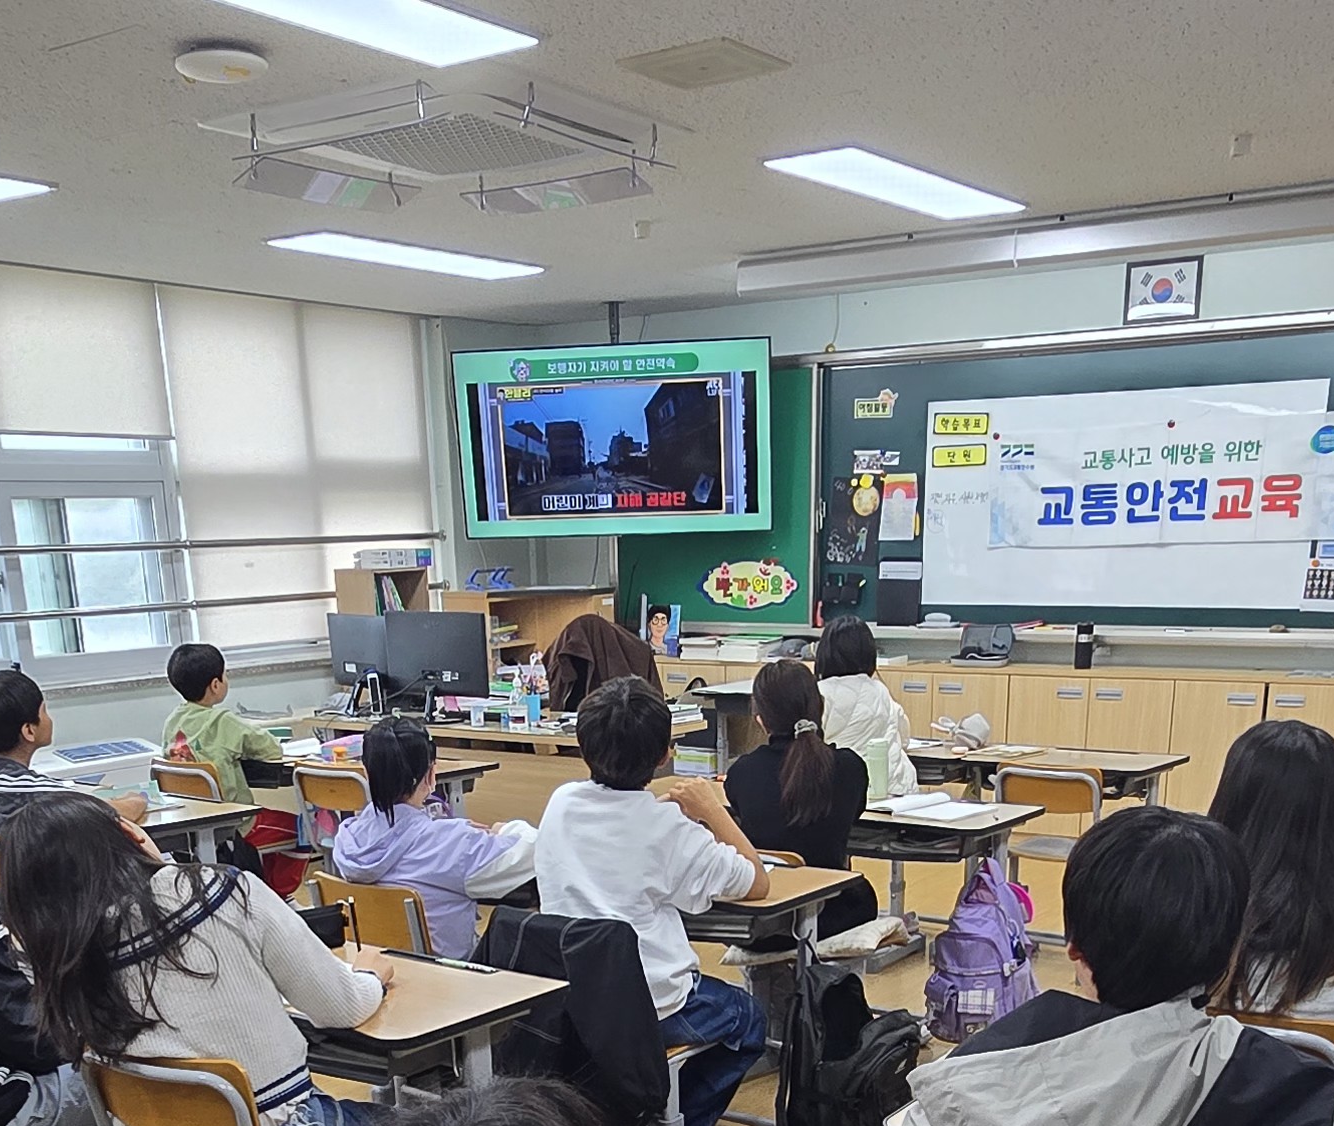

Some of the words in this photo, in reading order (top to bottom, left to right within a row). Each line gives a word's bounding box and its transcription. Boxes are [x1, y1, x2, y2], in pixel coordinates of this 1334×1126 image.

[940, 417, 981, 432] 학습목표
[1081, 446, 1153, 471] 교통사고
[1161, 443, 1216, 465] 예방을
[1224, 439, 1263, 463] 위한
[542, 494, 584, 511] 어린이
[646, 491, 687, 507] 공갈단
[1037, 473, 1303, 527] 교통안전교육
[715, 575, 783, 598] 반가워요
